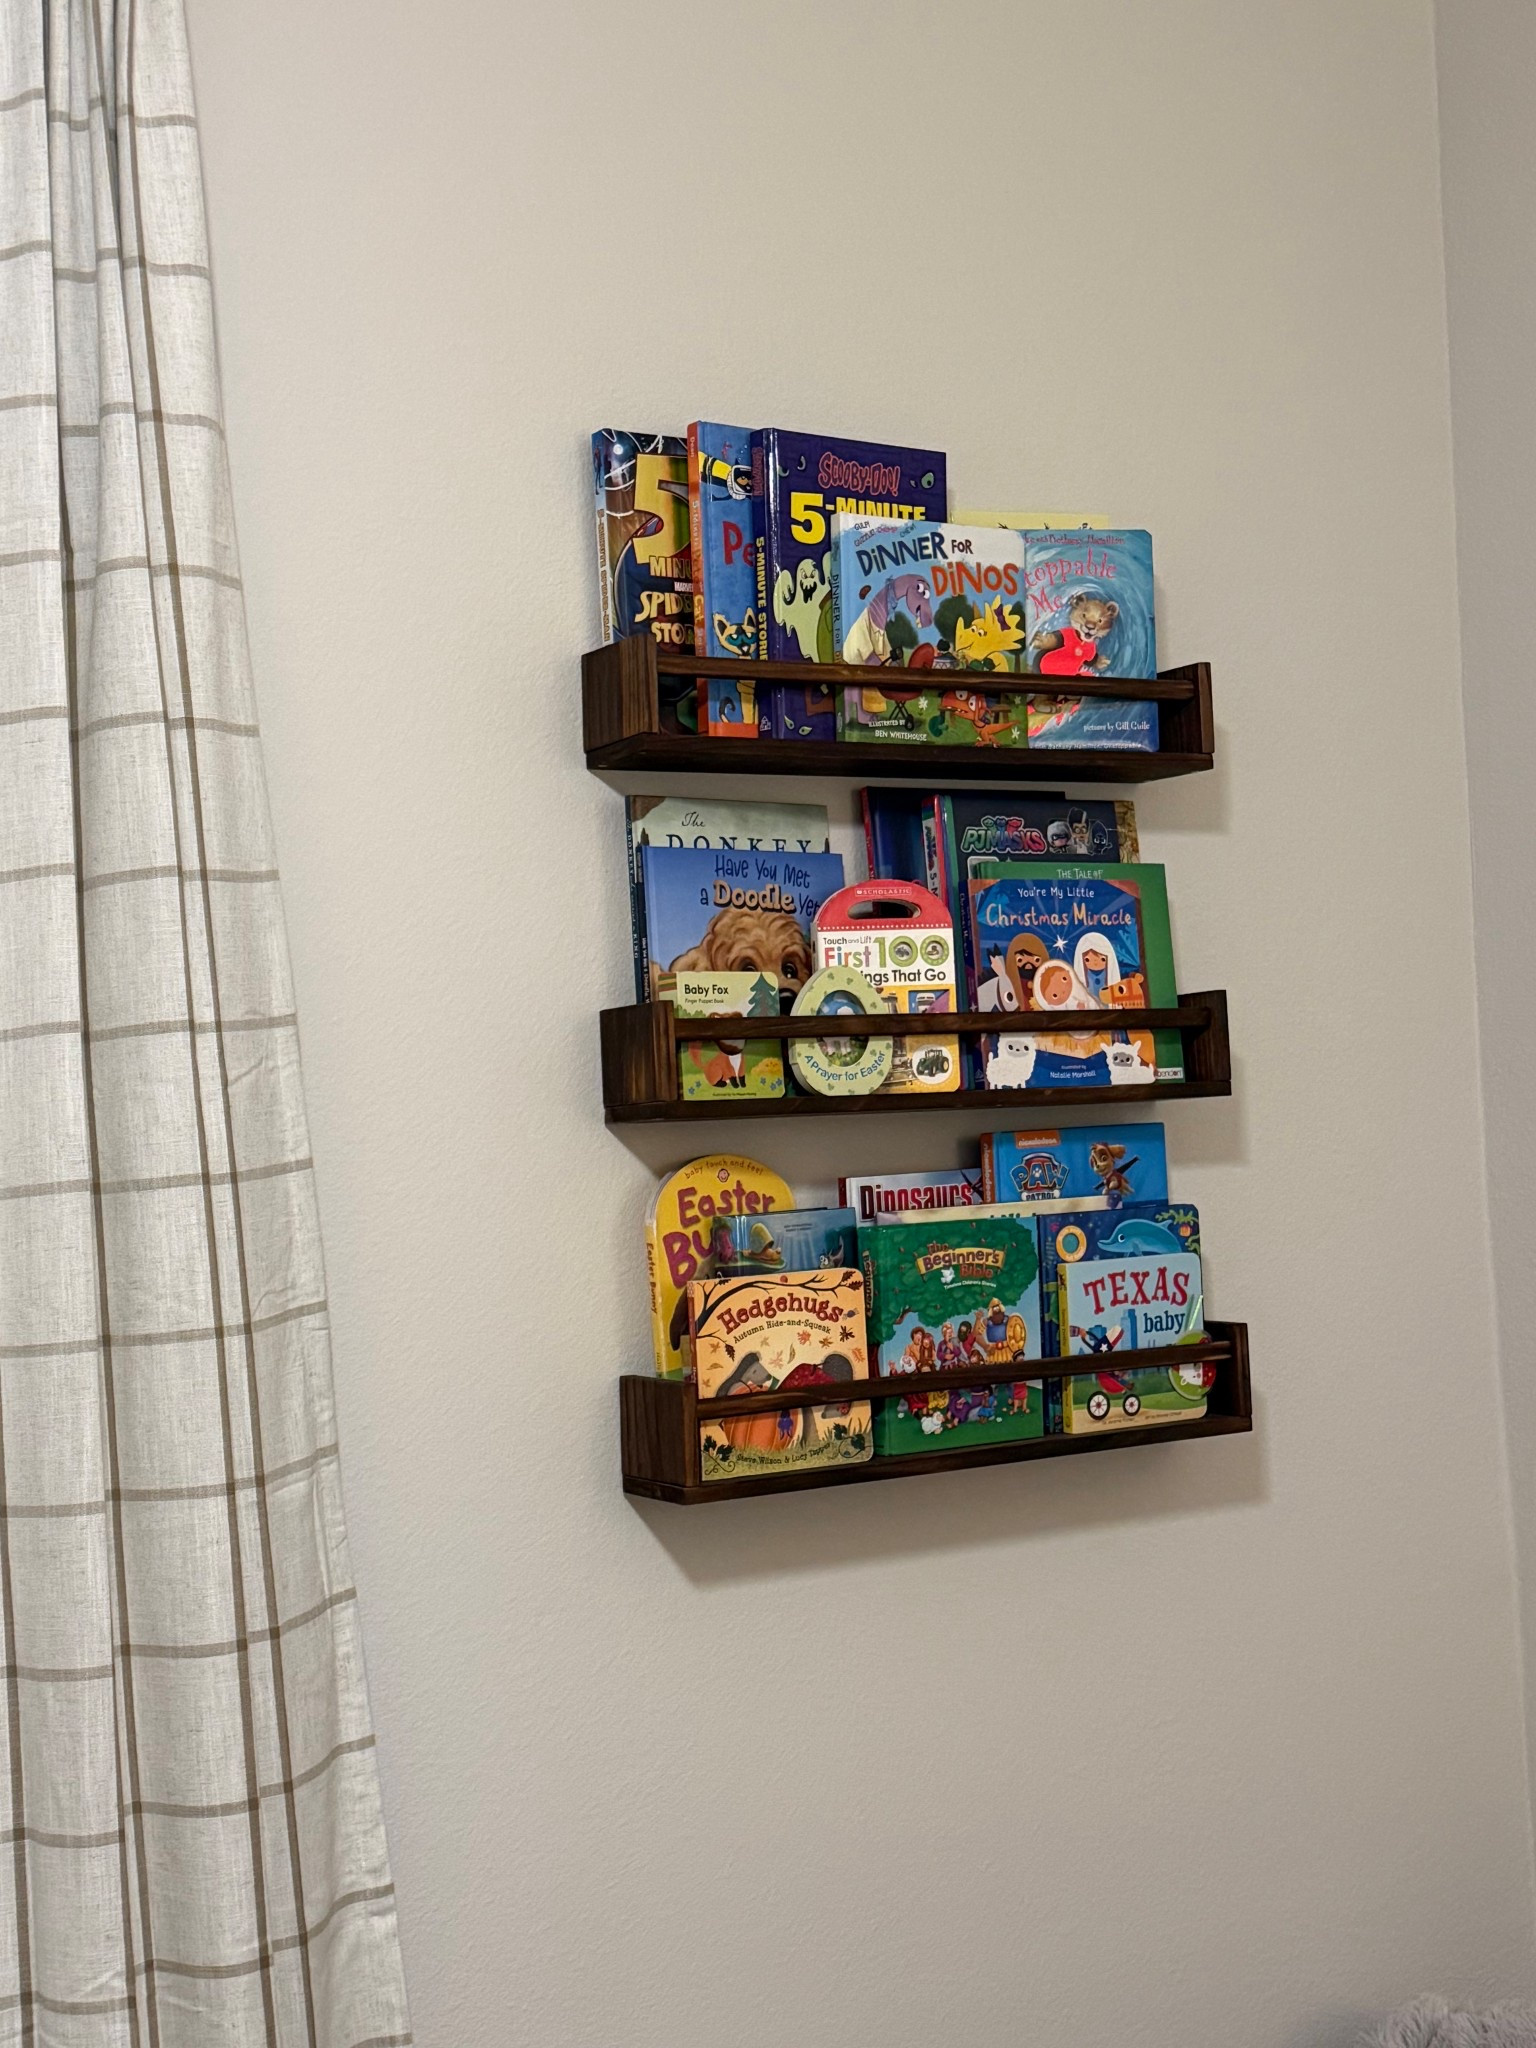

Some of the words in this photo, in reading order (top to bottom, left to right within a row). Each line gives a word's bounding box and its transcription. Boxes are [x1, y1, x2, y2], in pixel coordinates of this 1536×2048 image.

[818, 451, 900, 497] SCOOBY-DOO!
[756, 536, 767, 608] 5-MINUTE
[1028, 587, 1064, 621] Me
[875, 730, 887, 738] BEN
[682, 811, 706, 827] The
[715, 854, 749, 878] Have
[755, 858, 777, 880] You
[784, 864, 811, 889] Met
[1056, 869, 1072, 879] THE
[1074, 868, 1091, 879] TALE
[700, 888, 709, 906] a
[713, 880, 797, 914] Doodle
[1018, 887, 1046, 898] You're
[1051, 887, 1063, 898] My
[1067, 887, 1094, 898] Little
[986, 903, 1068, 927] Christmas
[1073, 902, 1132, 925] Miracle
[824, 946, 871, 968] First
[873, 935, 950, 968] 100
[892, 969, 921, 982] That
[924, 968, 946, 981] Go
[684, 984, 709, 997] Baby
[712, 984, 729, 995] Fox
[804, 1054, 814, 1064] A
[811, 1062, 842, 1081] Prayer
[845, 1071, 858, 1081] for
[860, 1051, 886, 1078] Easter
[1050, 1071, 1071, 1079] Natalie
[1072, 1070, 1096, 1079] Marshall
[685, 1165, 703, 1179] baby
[705, 1159, 727, 1168] touch
[730, 1159, 744, 1168] and
[747, 1162, 763, 1176] feel
[1010, 1162, 1069, 1192] PAW
[677, 1180, 775, 1229] Easter
[859, 1183, 974, 1220] Dinosaurs
[1025, 1192, 1056, 1201] PATROL
[923, 1250, 1000, 1271] Beginner's
[927, 1242, 949, 1255] The
[960, 1263, 994, 1278] Bible
[1082, 1266, 1190, 1315] TEXAS
[716, 1293, 844, 1335] Hedgehugs
[1143, 1310, 1185, 1334] baby
[733, 1325, 765, 1344] Autumn
[766, 1319, 832, 1335] Hide-and-Squeak
[792, 1452, 808, 1462] Lucy
